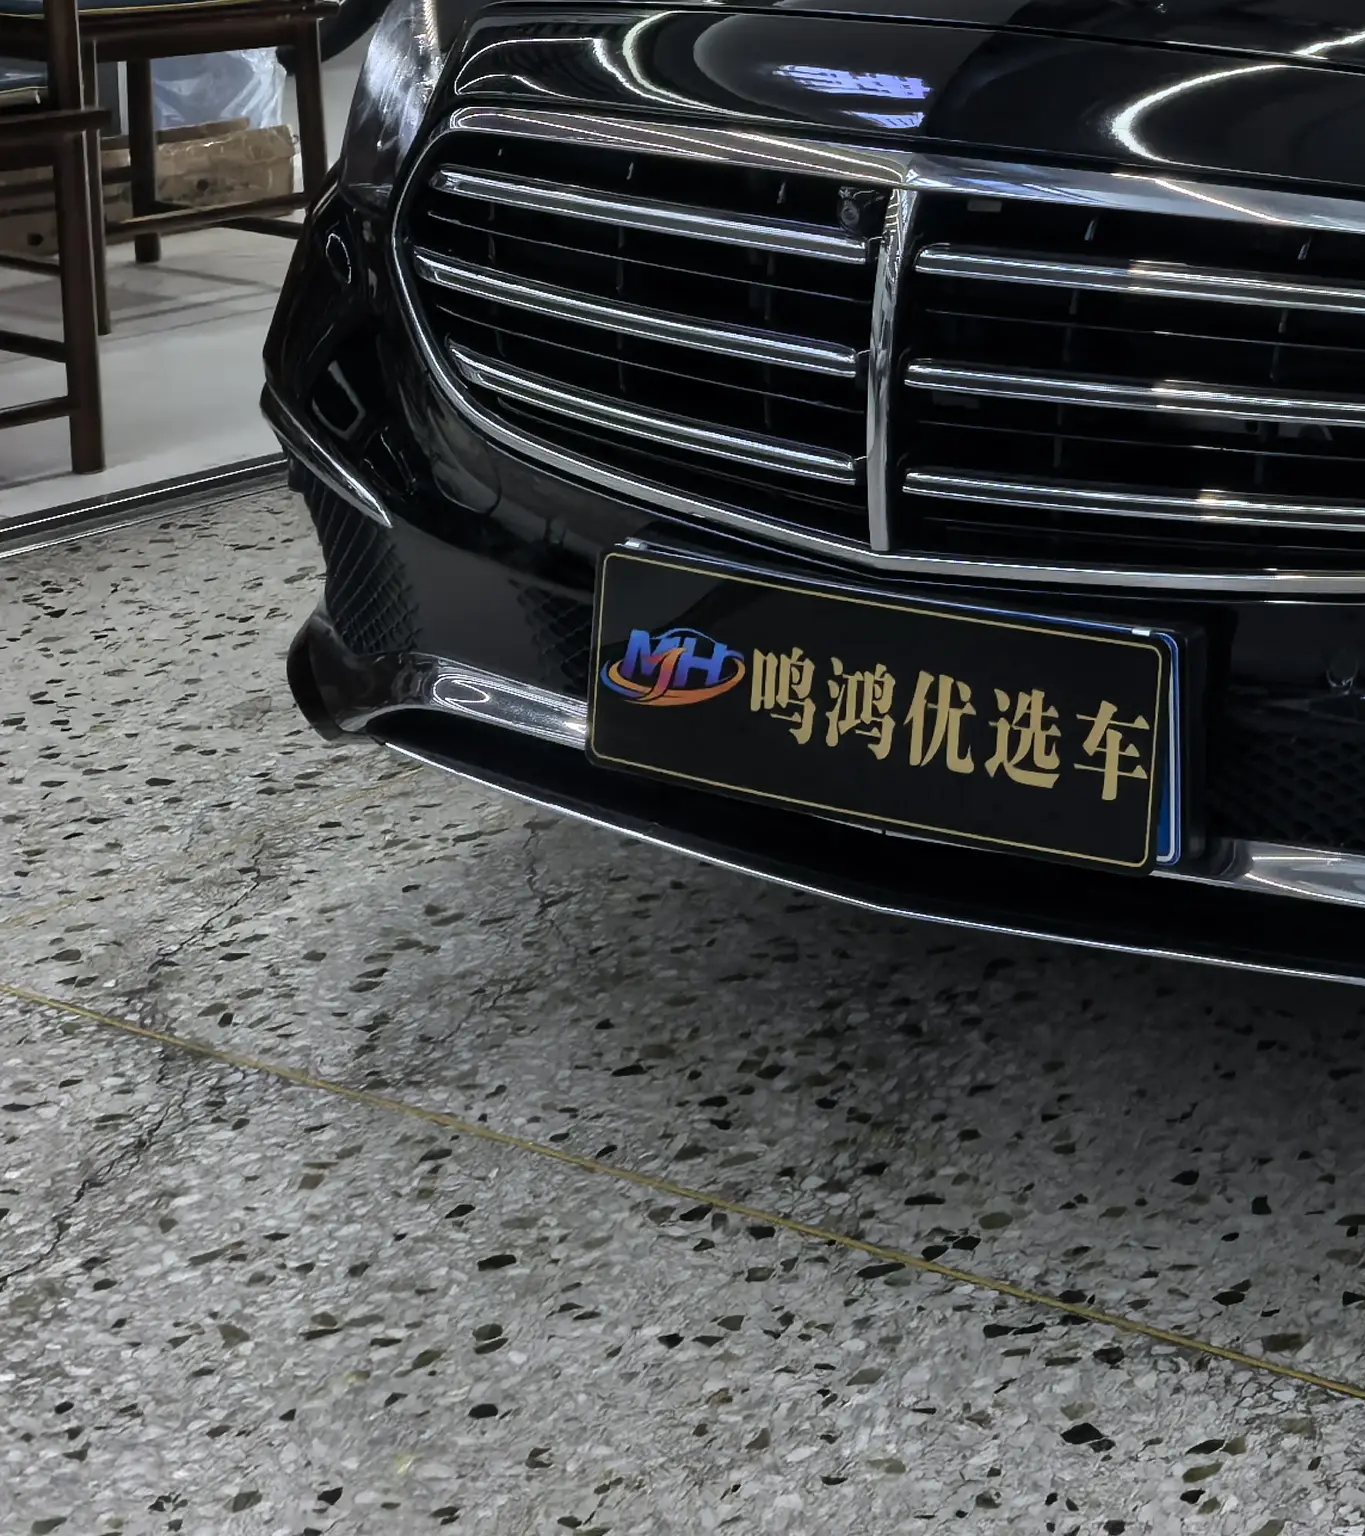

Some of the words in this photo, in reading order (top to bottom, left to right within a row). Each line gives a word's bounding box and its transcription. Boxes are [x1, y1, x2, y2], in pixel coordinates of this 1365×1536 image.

[621, 628, 728, 688] MH
[749, 646, 1151, 801] 鸣鸿优选车
